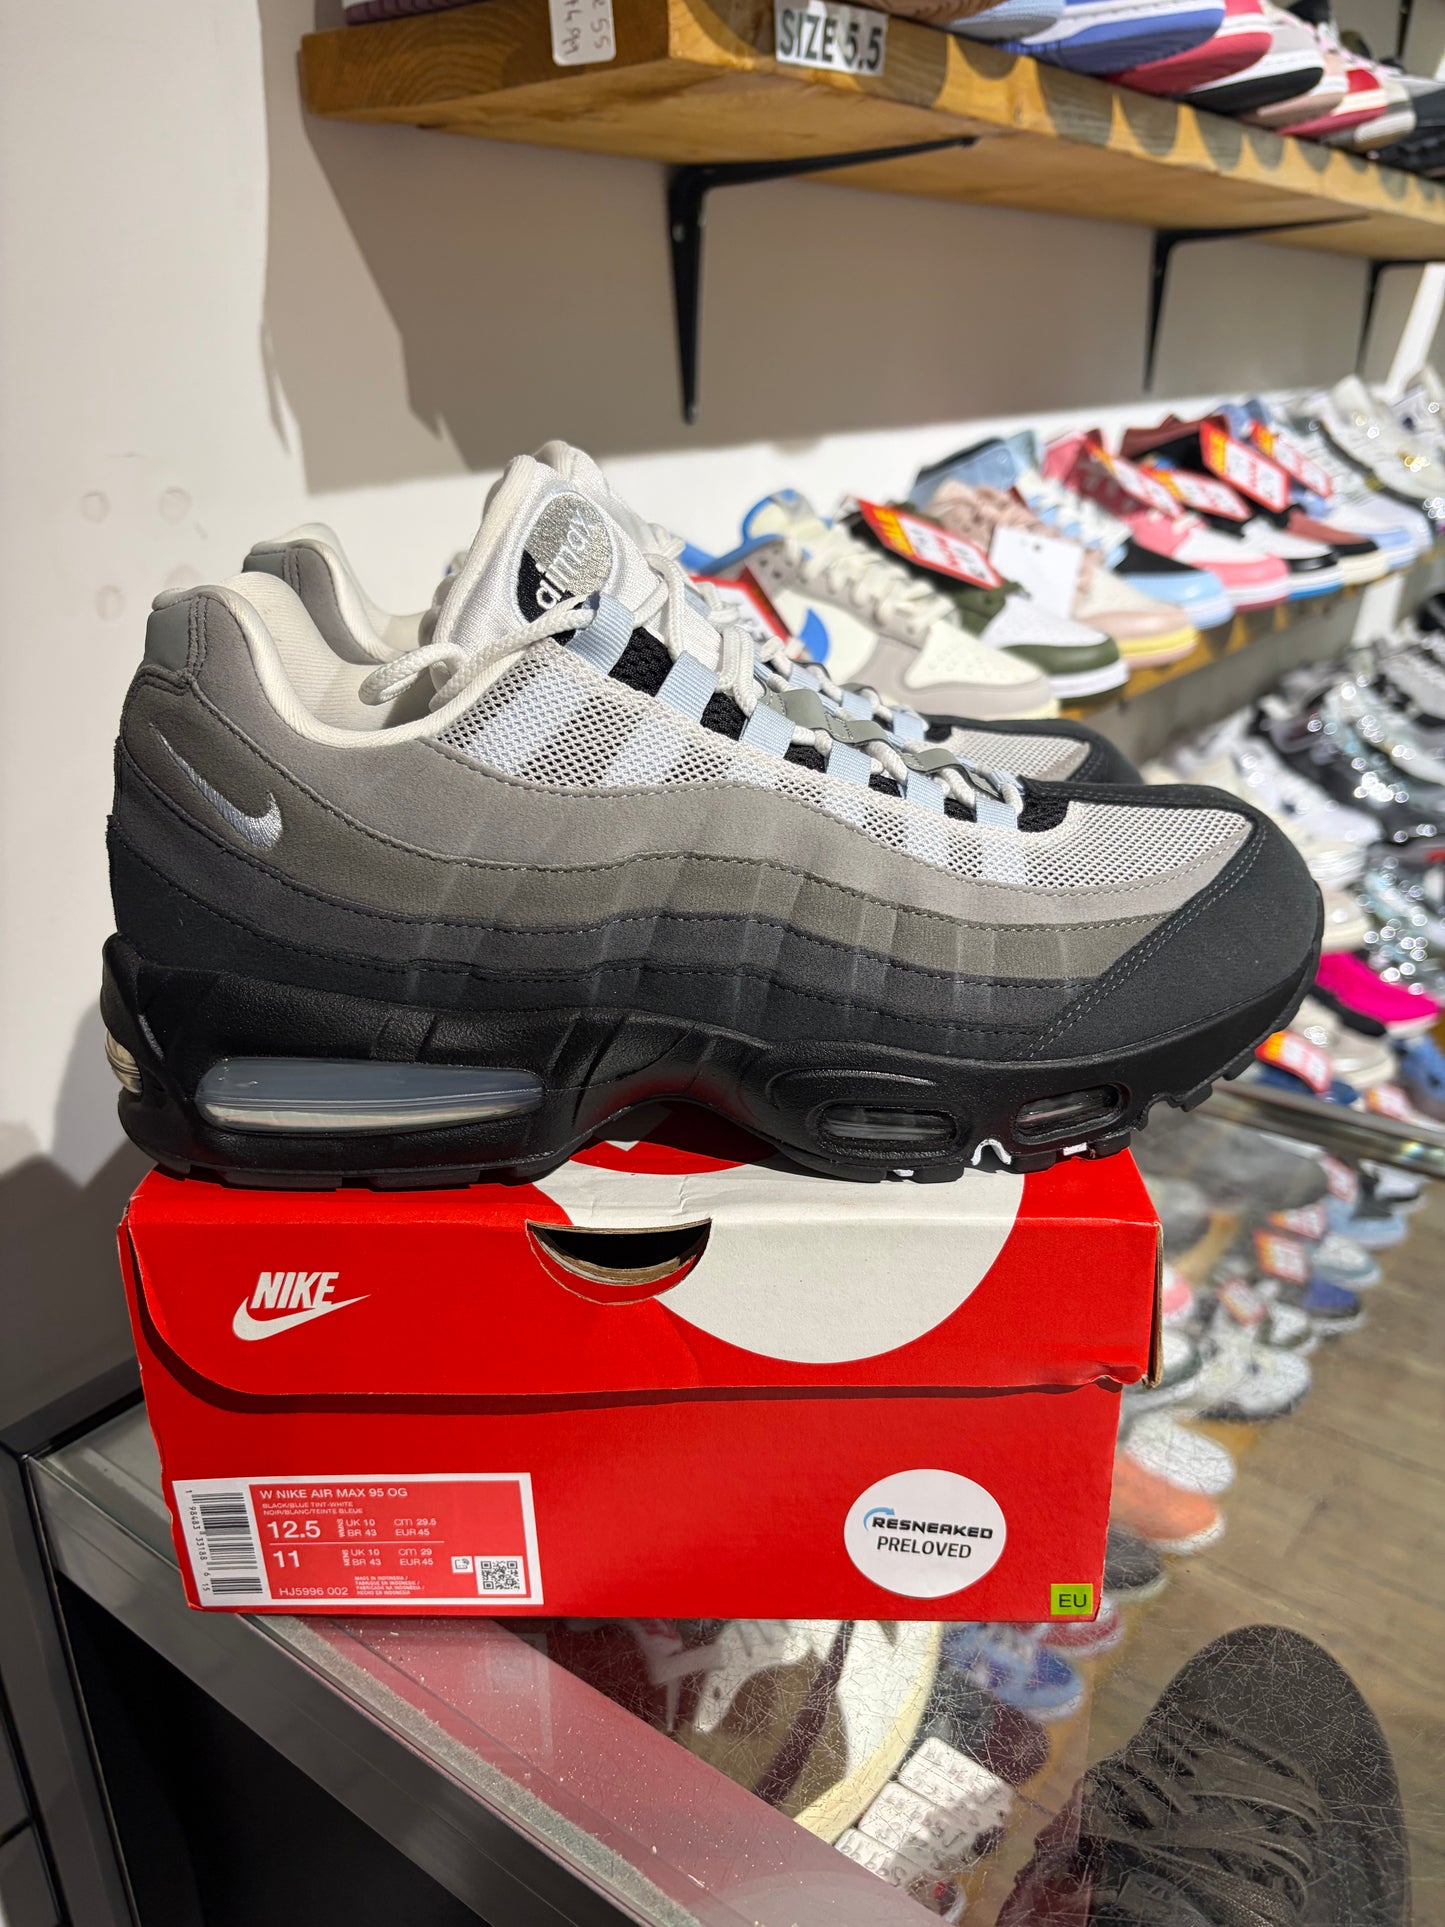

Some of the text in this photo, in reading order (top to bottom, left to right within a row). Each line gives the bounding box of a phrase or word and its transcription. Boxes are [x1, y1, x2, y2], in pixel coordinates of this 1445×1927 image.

[779, 8, 883, 70] SIZE 5.5
[250, 1271, 340, 1309] NIKE
[259, 1487, 408, 1499] W NIKE AIR MAX 95 OG
[345, 1518, 376, 1527] UK 10
[416, 1517, 437, 1526] 29.5
[871, 1516, 993, 1539] RESNEAKED
[267, 1520, 321, 1539] 12.5
[347, 1528, 378, 1537] BR 43
[395, 1528, 431, 1537] EUR 45
[350, 1548, 381, 1557] UK 10
[420, 1547, 433, 1556] 29
[876, 1535, 972, 1559] PRELOVED
[272, 1549, 301, 1568] 11
[352, 1558, 382, 1567] BR 43
[399, 1557, 434, 1567] EUR 45
[279, 1585, 349, 1597] HJ5996 002
[1058, 1593, 1087, 1608] EU
